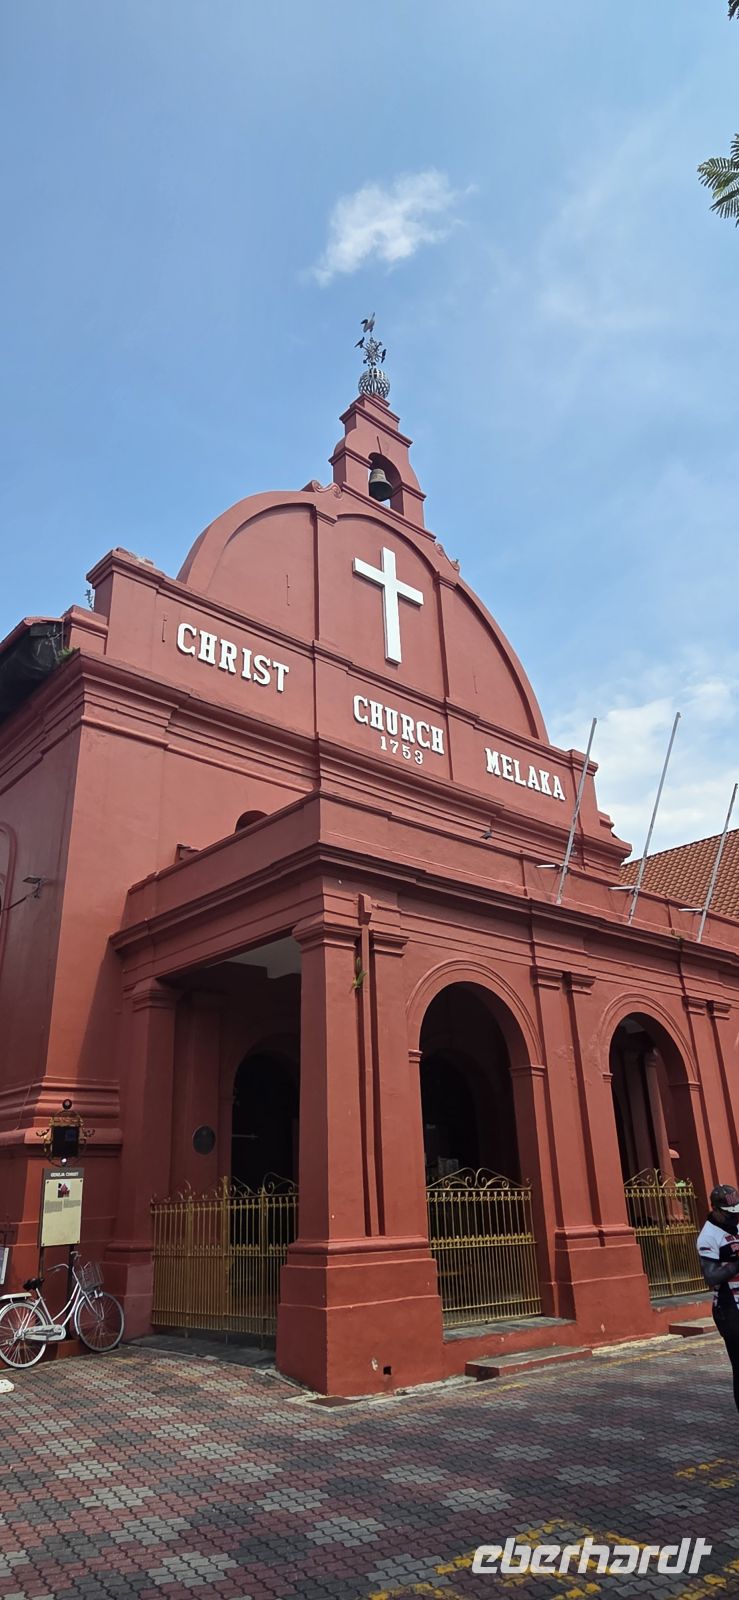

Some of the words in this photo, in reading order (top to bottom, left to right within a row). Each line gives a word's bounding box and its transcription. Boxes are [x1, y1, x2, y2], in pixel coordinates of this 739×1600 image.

[177, 622, 290, 692] CHRIST
[353, 694, 445, 755] CHURCH
[484, 747, 566, 801] MELAKA
[380, 735, 424, 765] 1753
